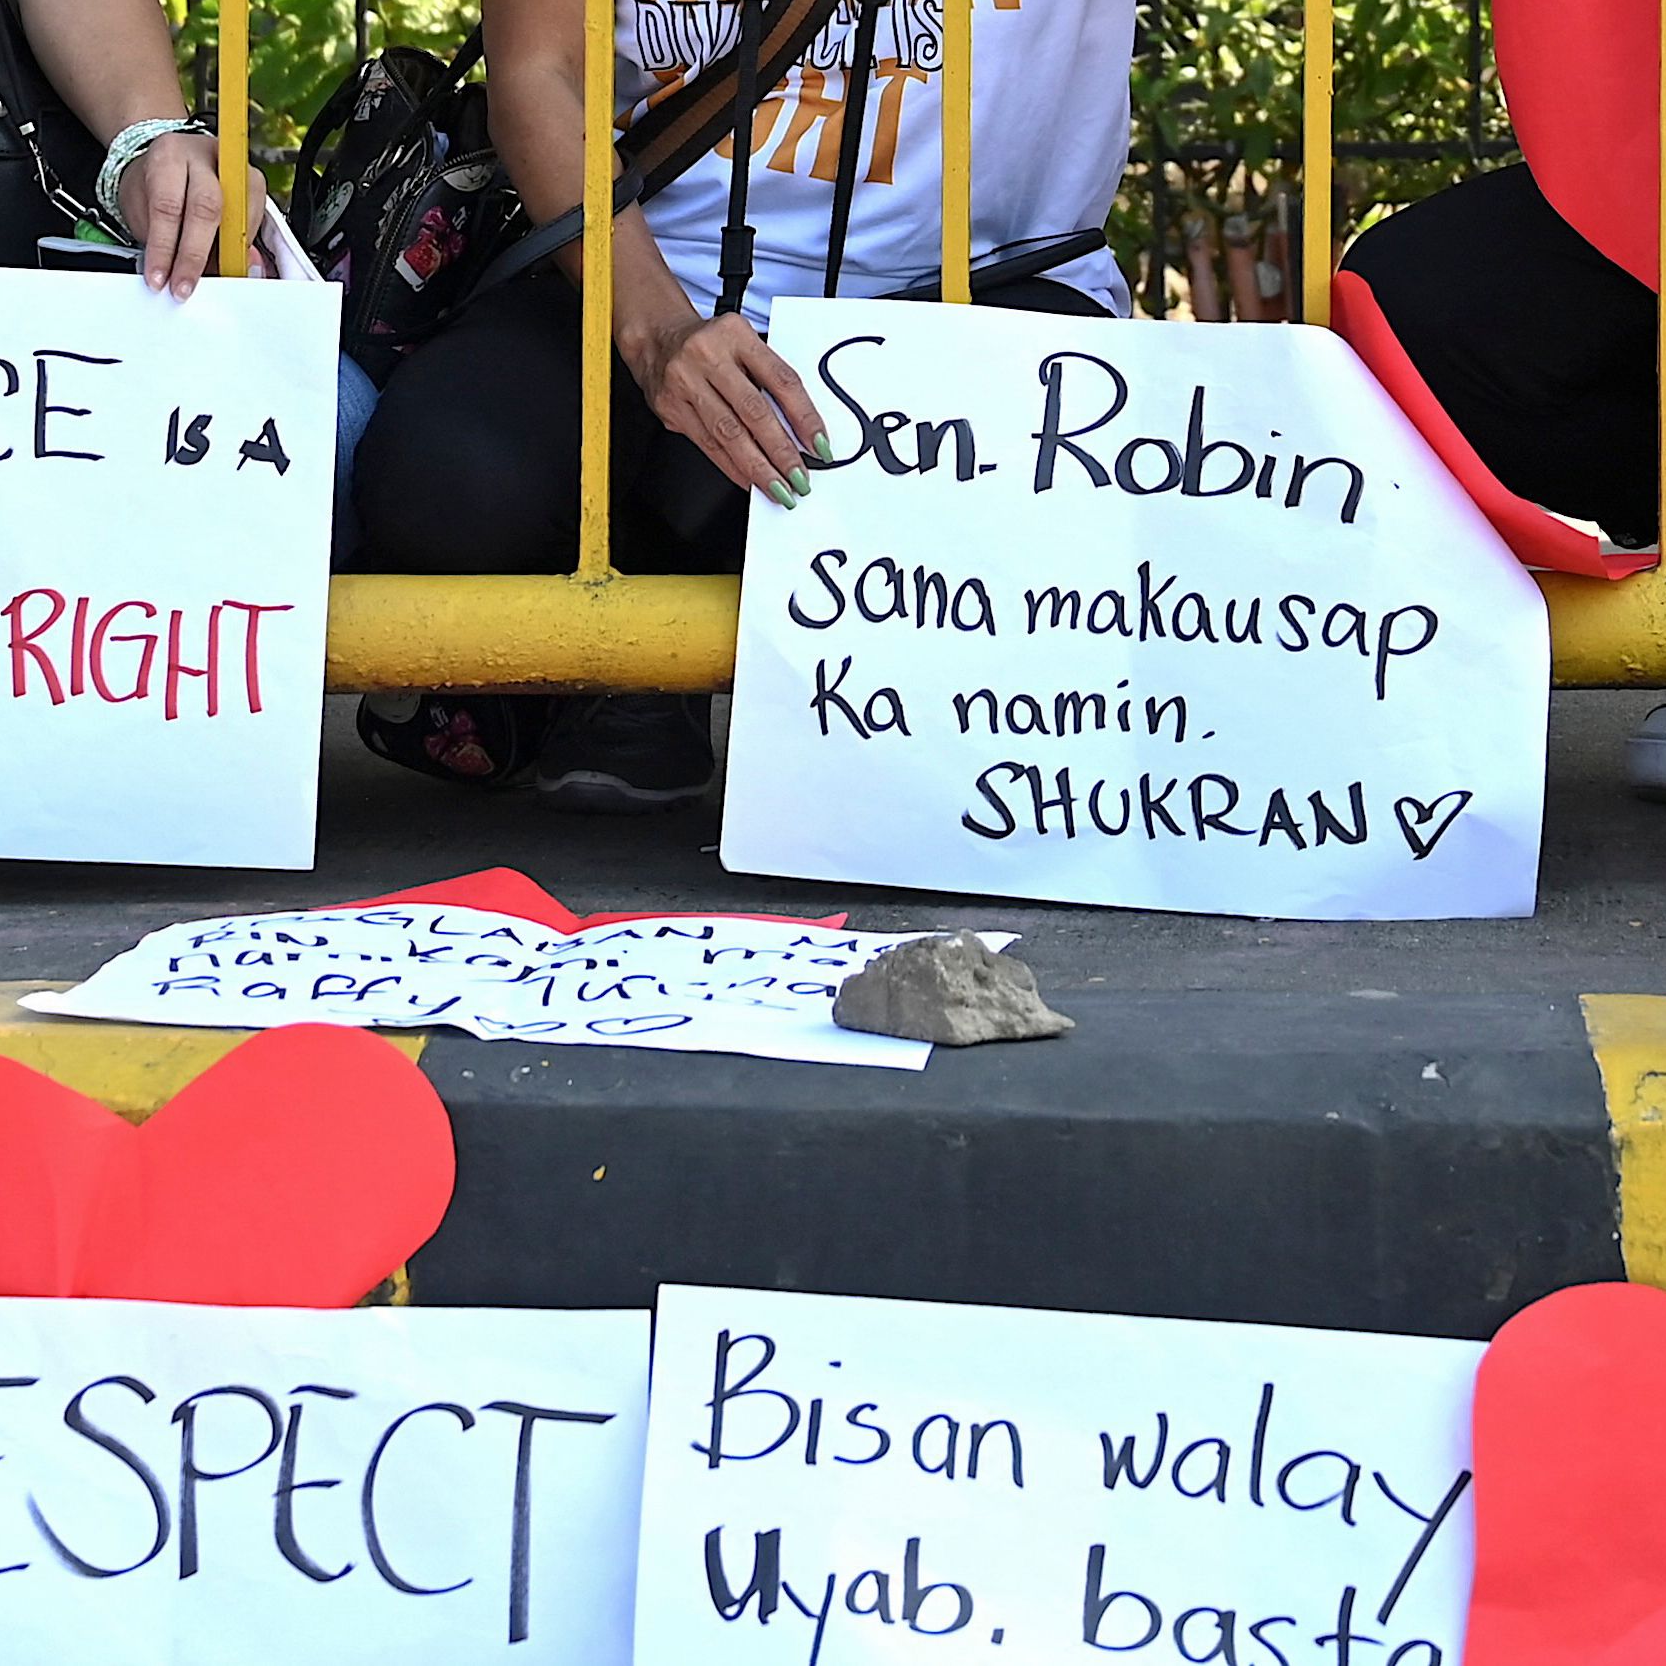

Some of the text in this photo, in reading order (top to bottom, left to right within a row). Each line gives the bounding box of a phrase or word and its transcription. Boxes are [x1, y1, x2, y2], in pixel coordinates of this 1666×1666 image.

[164, 405, 213, 466] IS
[237, 416, 291, 476] A
[801, 335, 1365, 524] Sen. Robin
[0, 587, 295, 721] RIGHT
[961, 760, 1368, 851] SHUKRAN
[151, 974, 443, 1017] Raffy
[690, 1328, 1473, 1627] Bisan walay
